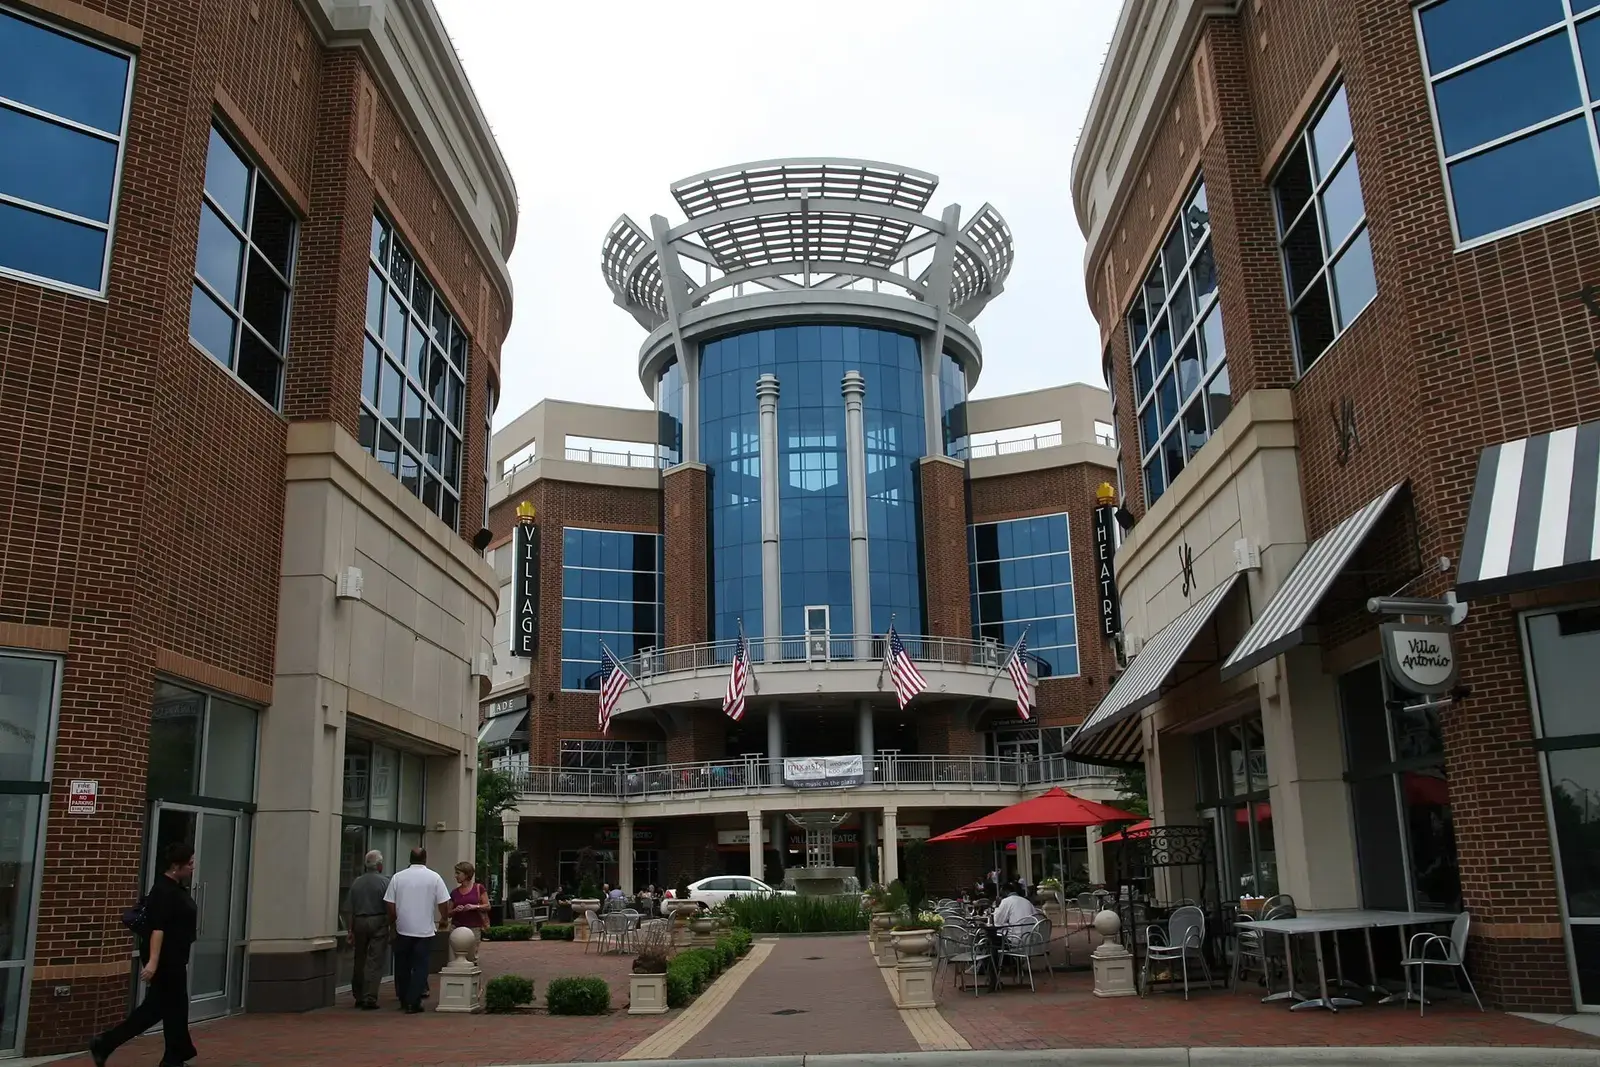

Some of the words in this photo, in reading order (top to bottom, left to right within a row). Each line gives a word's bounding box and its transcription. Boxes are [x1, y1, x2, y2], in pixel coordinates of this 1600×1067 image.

[521, 526, 536, 651] VILLAGE
[1095, 507, 1113, 634] THEATRE
[1402, 655, 1451, 670] Antonio
[1408, 638, 1440, 654] Villa
